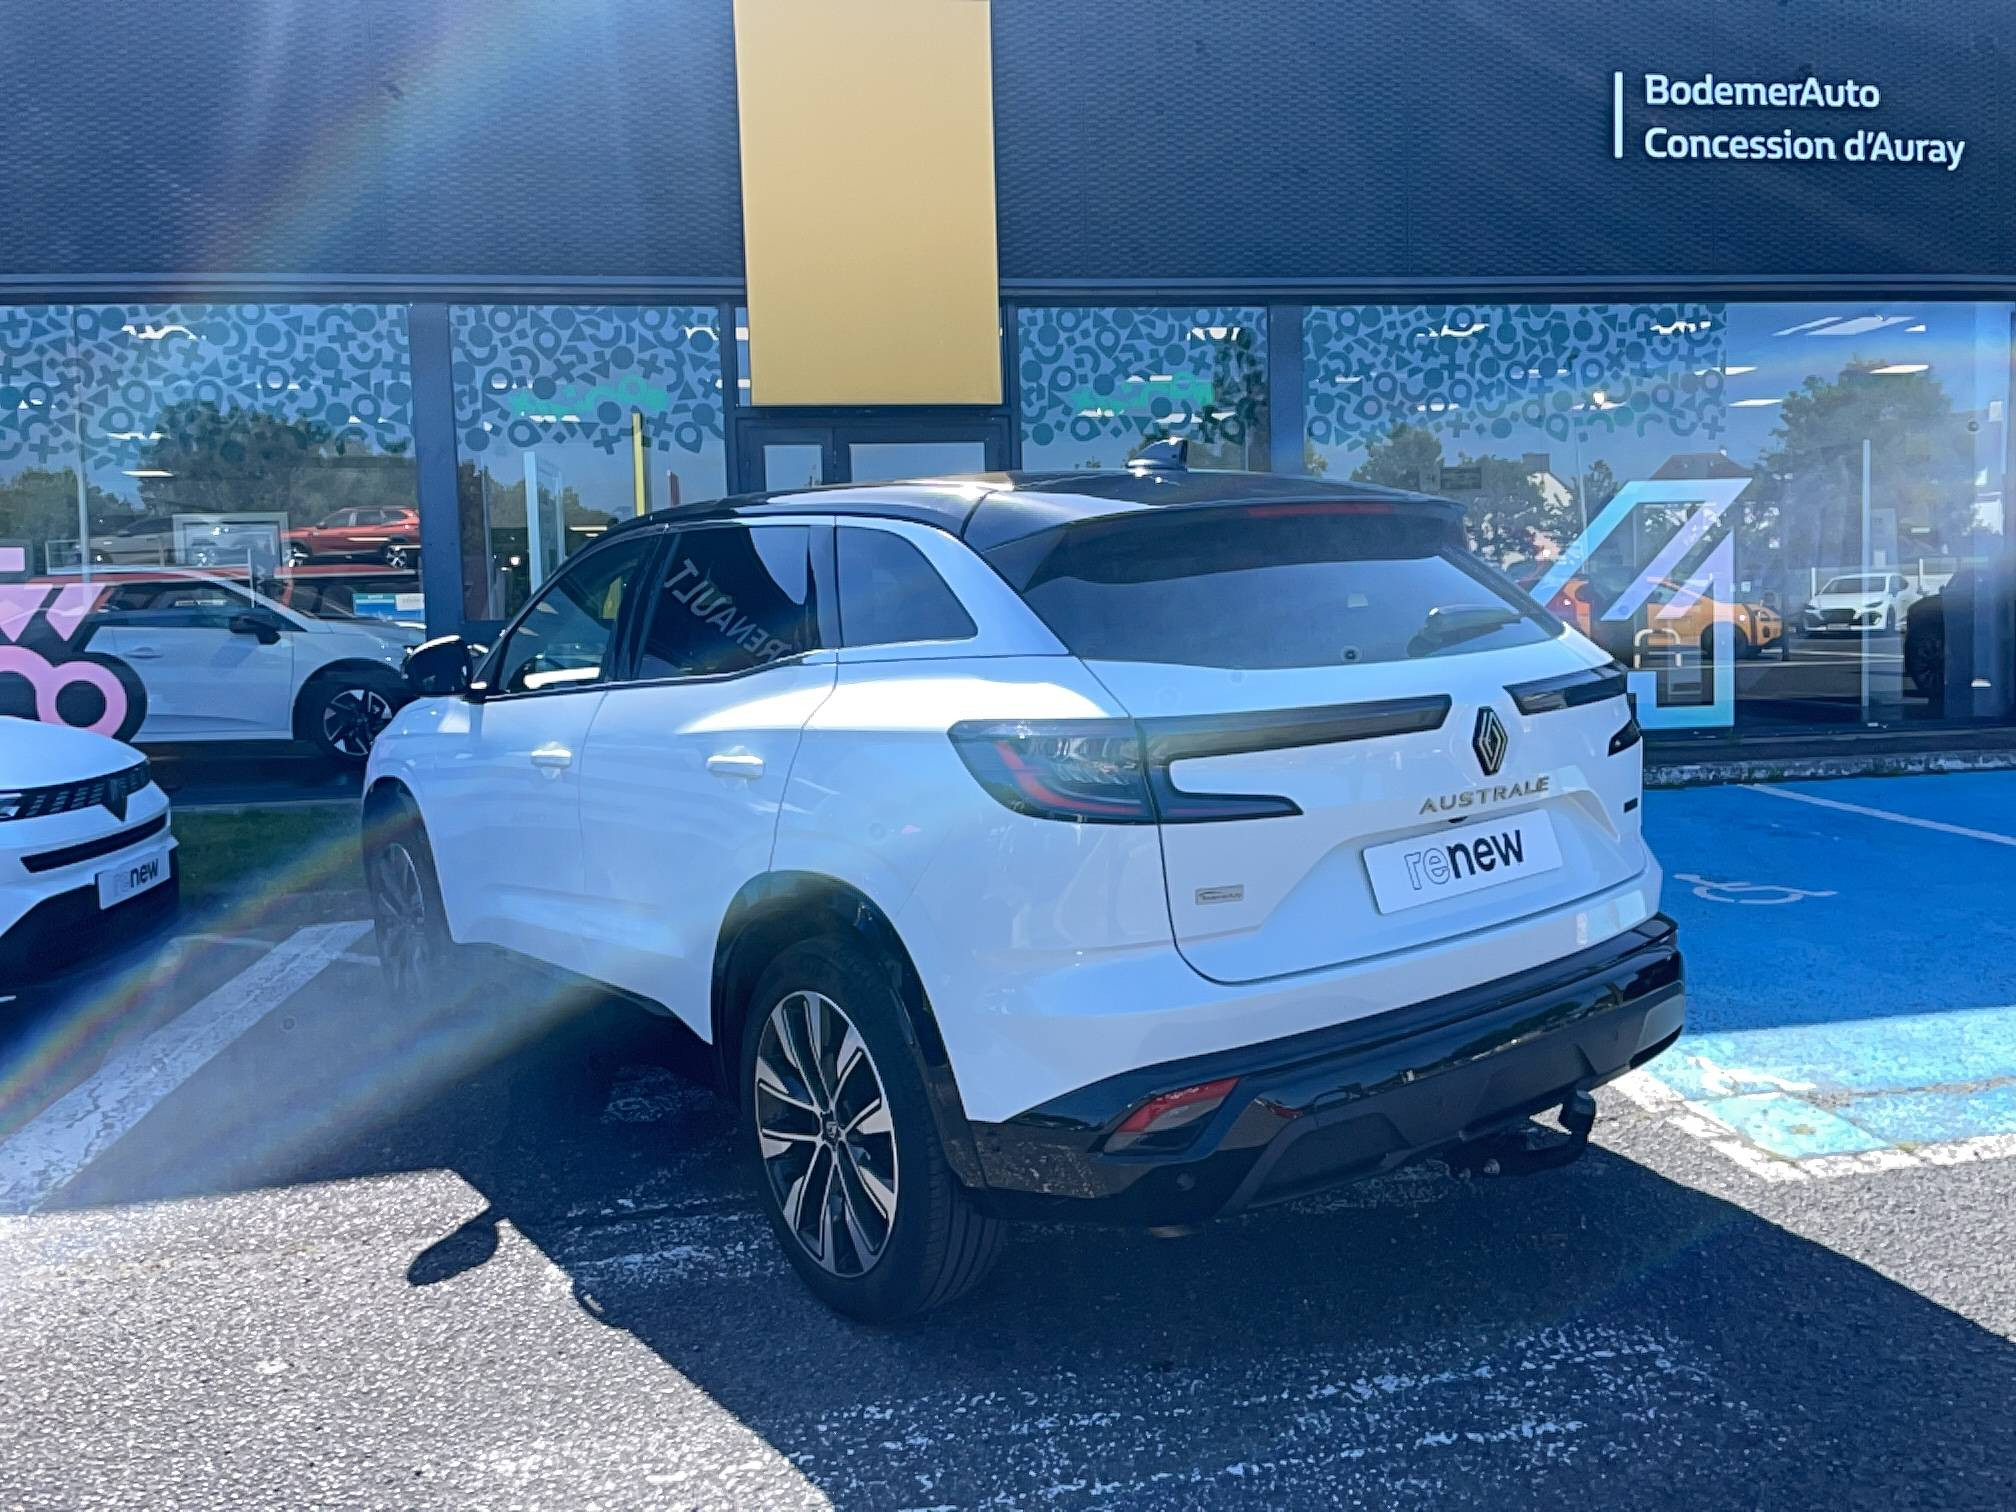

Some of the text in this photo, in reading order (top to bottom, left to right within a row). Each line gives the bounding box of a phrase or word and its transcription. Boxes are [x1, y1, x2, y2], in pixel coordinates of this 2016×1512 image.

[1645, 73, 1880, 107] BodemerAuto
[1645, 127, 1966, 171] Concession d'Auray
[1419, 776, 1550, 815] AUSTRALE
[1404, 829, 1524, 890] renew
